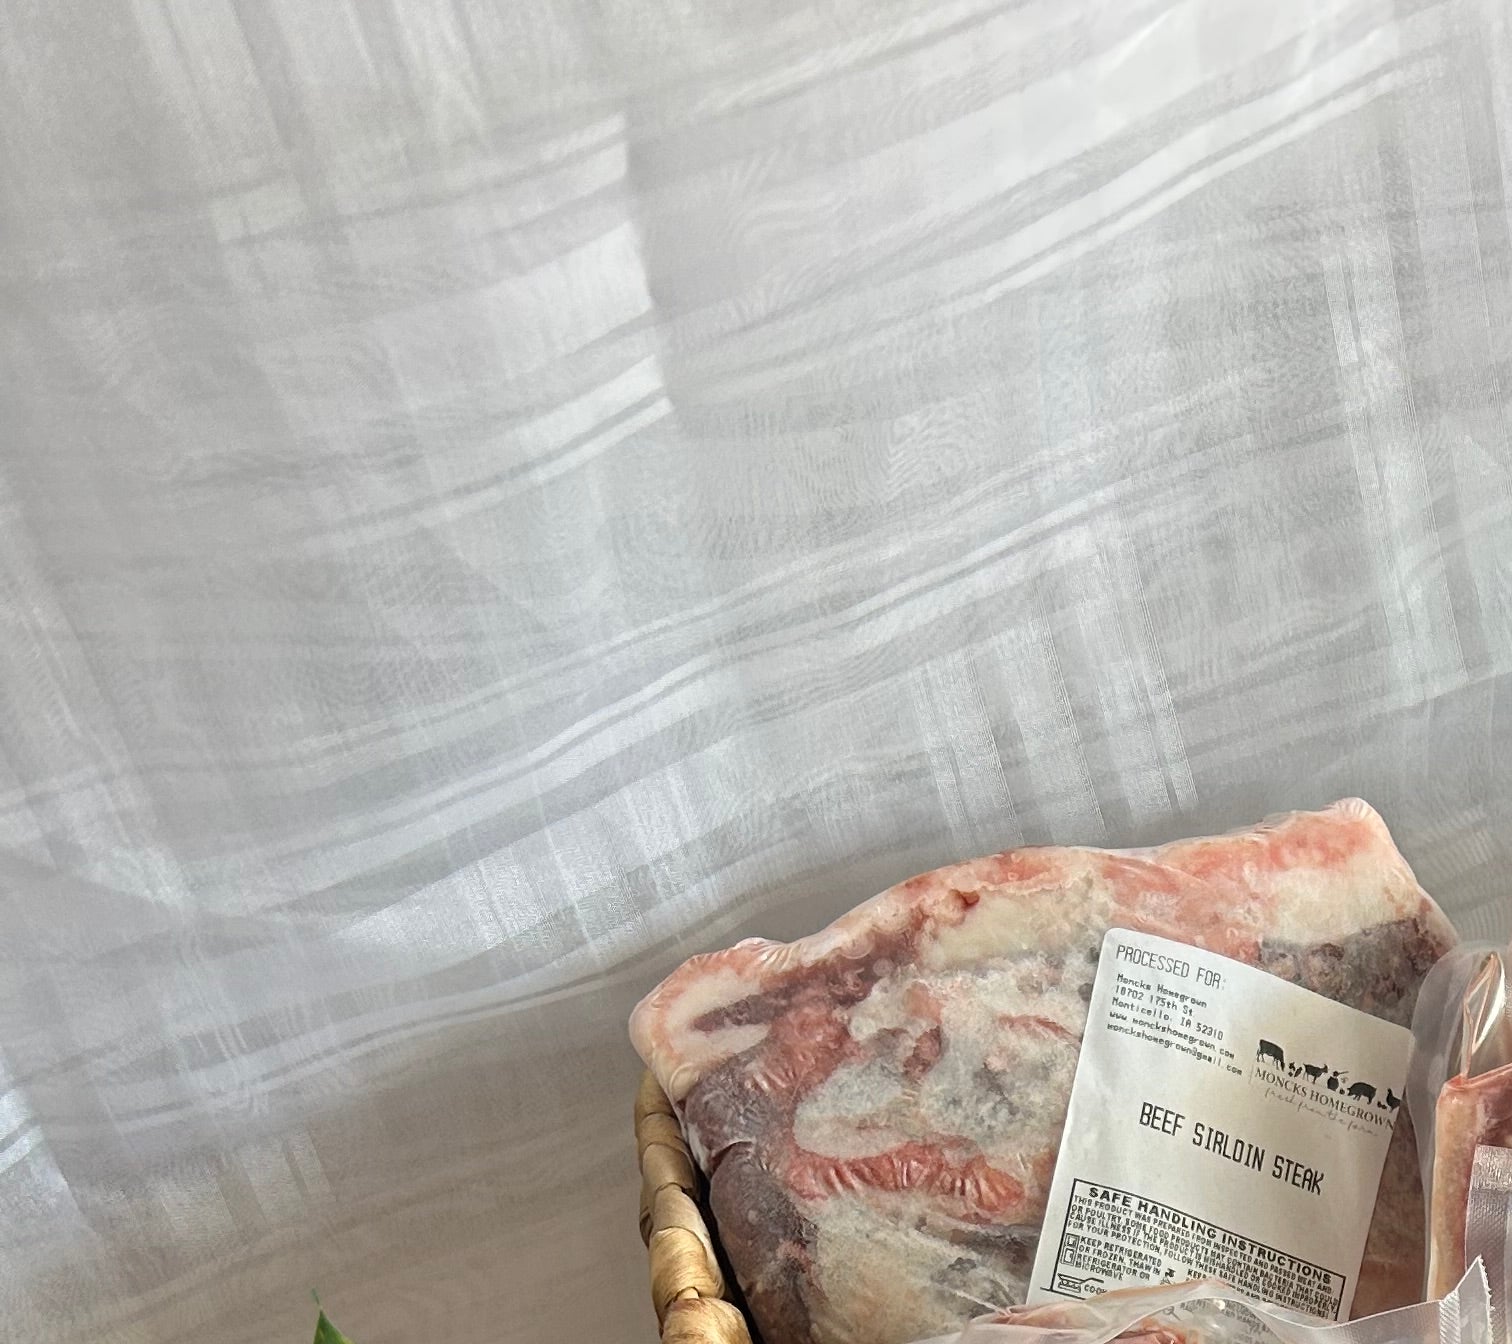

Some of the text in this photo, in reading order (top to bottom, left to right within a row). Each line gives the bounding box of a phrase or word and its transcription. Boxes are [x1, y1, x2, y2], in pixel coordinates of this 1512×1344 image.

[1114, 942, 1228, 991] PROCESSED FOR:
[1115, 972, 1209, 1010] Moncks Homegrown
[1148, 994, 1178, 1011] 175th
[1178, 1017, 1192, 1030] IA
[1194, 1022, 1224, 1041] 52310
[1253, 1067, 1309, 1098] MONCKS
[1137, 1100, 1326, 1196] BEEF SIRLOIN STEAK
[1087, 1182, 1333, 1285] SAFE HANDLING INSTRUCTIONS
